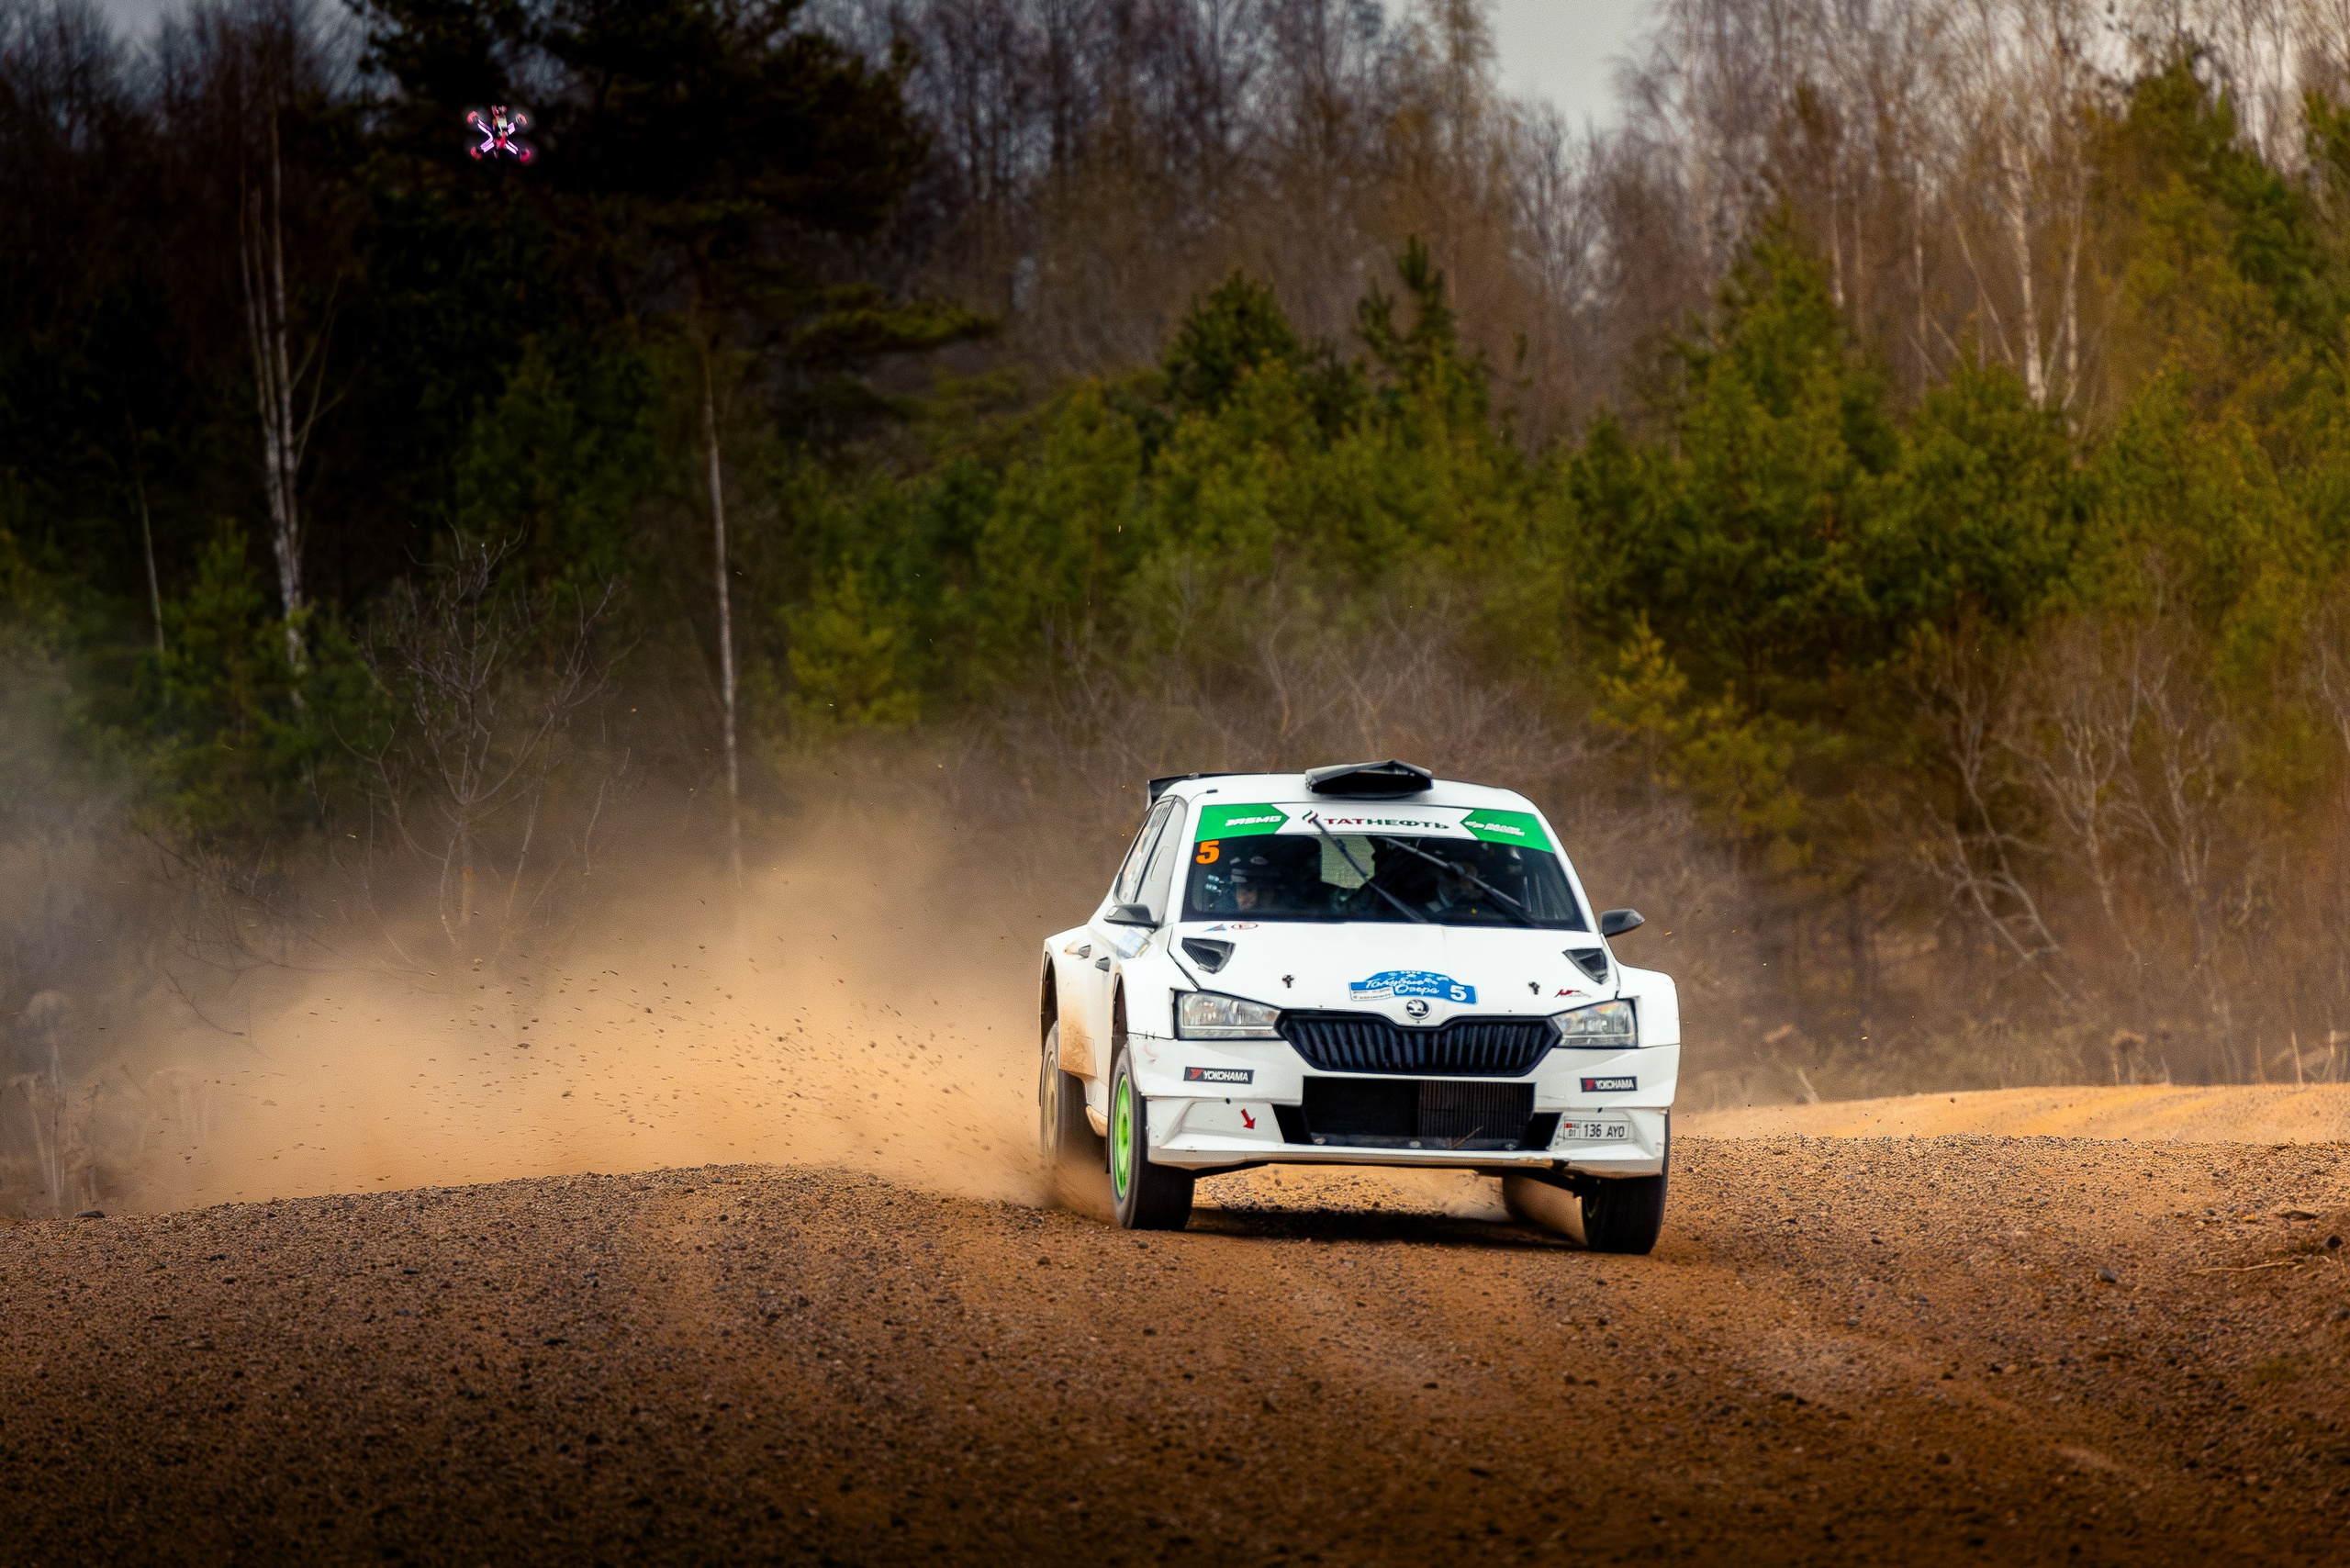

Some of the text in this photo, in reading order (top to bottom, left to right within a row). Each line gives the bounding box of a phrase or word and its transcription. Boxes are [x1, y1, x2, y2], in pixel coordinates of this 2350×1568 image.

[1324, 817, 1449, 829] ТАТНЕФТЬ
[1195, 840, 1220, 865] 5
[1449, 984, 1468, 1002] 5
[1203, 1070, 1248, 1081] YOKOHAMA
[1595, 1079, 1635, 1090] YOKOHAMA
[1583, 1123, 1603, 1138] 136
